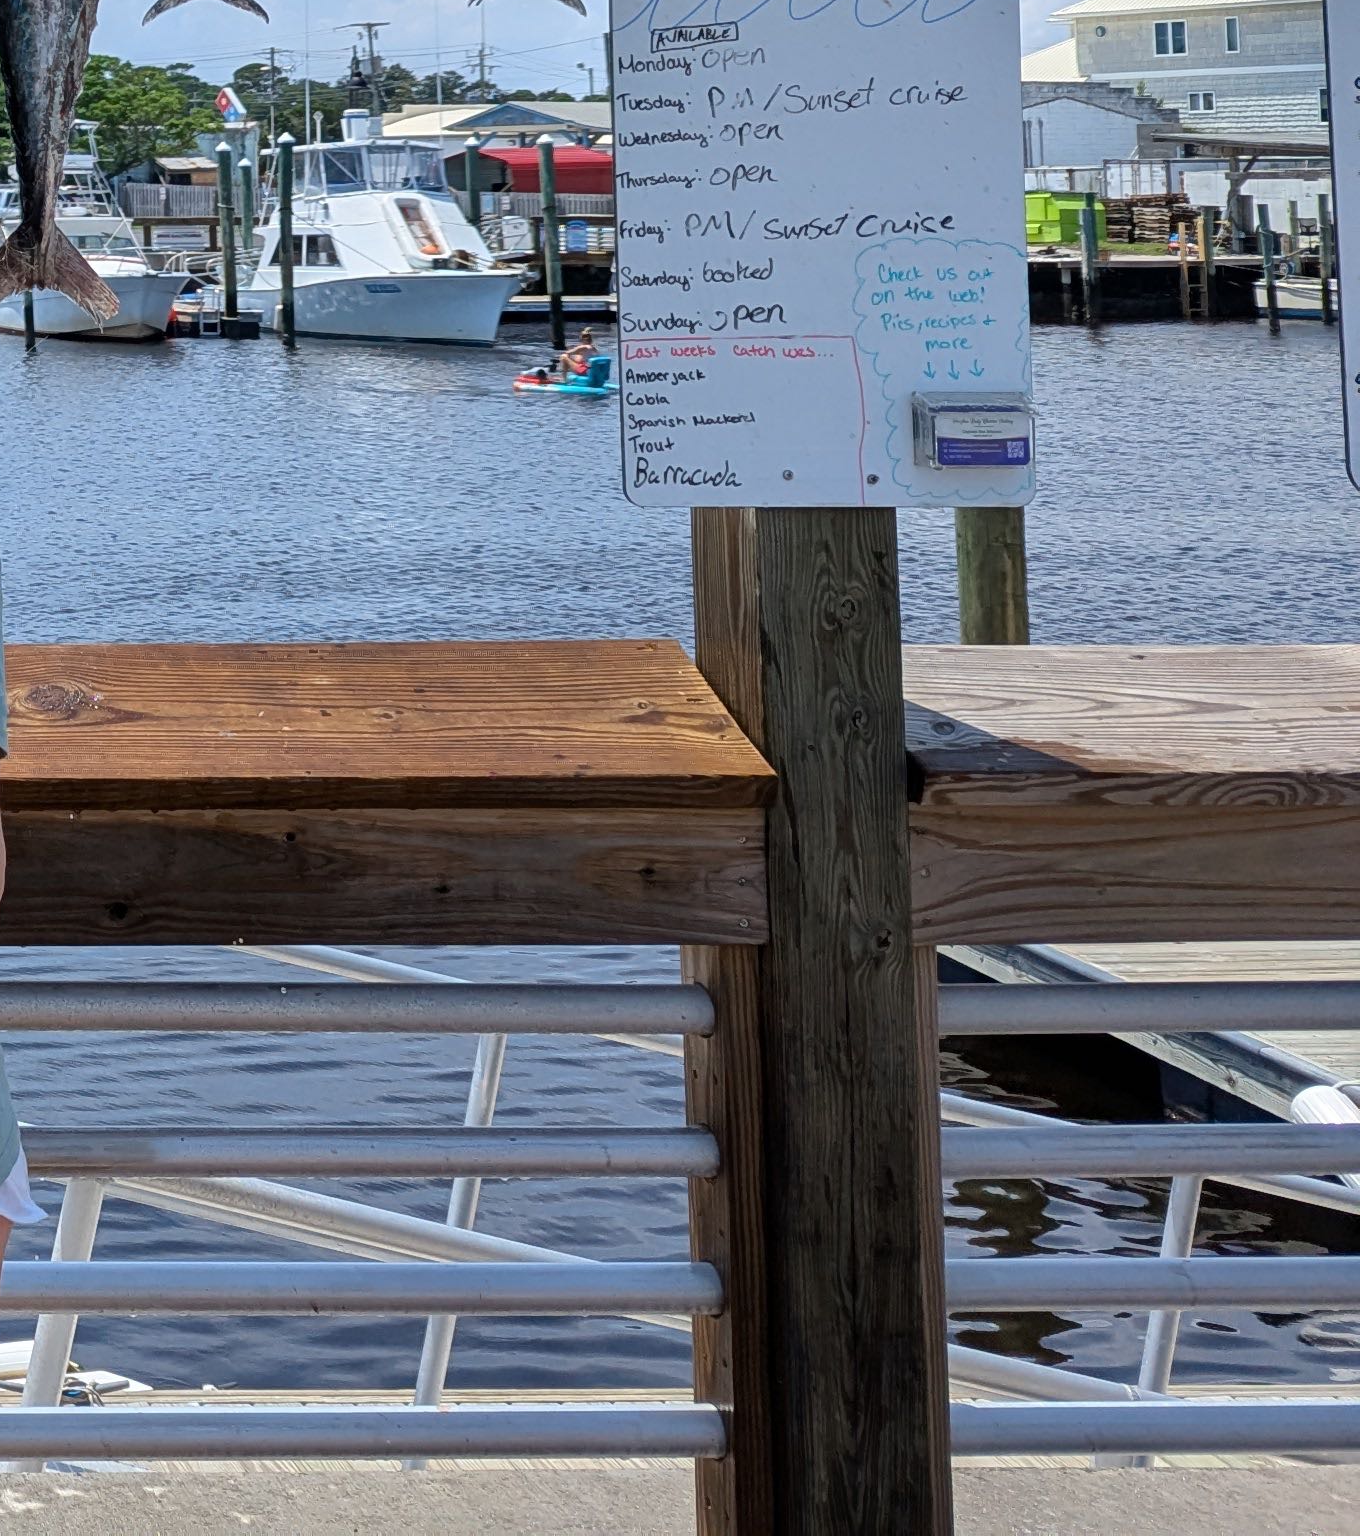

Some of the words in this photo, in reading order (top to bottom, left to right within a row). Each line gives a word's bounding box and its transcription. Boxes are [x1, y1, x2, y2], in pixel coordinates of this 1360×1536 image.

[655, 27, 731, 50] AVAILABLE
[618, 48, 697, 77] Monday:
[616, 91, 692, 114] Tuesday:
[618, 124, 714, 148] Wednesday:
[616, 168, 702, 189] Thursday:
[621, 266, 695, 292] Saturday:
[702, 257, 774, 284] booked
[878, 263, 925, 284] Check
[871, 289, 895, 306] on
[621, 310, 703, 335] Sunday:
[625, 343, 661, 361] Last
[925, 337, 972, 353] more
[628, 414, 686, 431] Spanish
[628, 435, 675, 453] Trout
[634, 456, 743, 488] Barracuda
